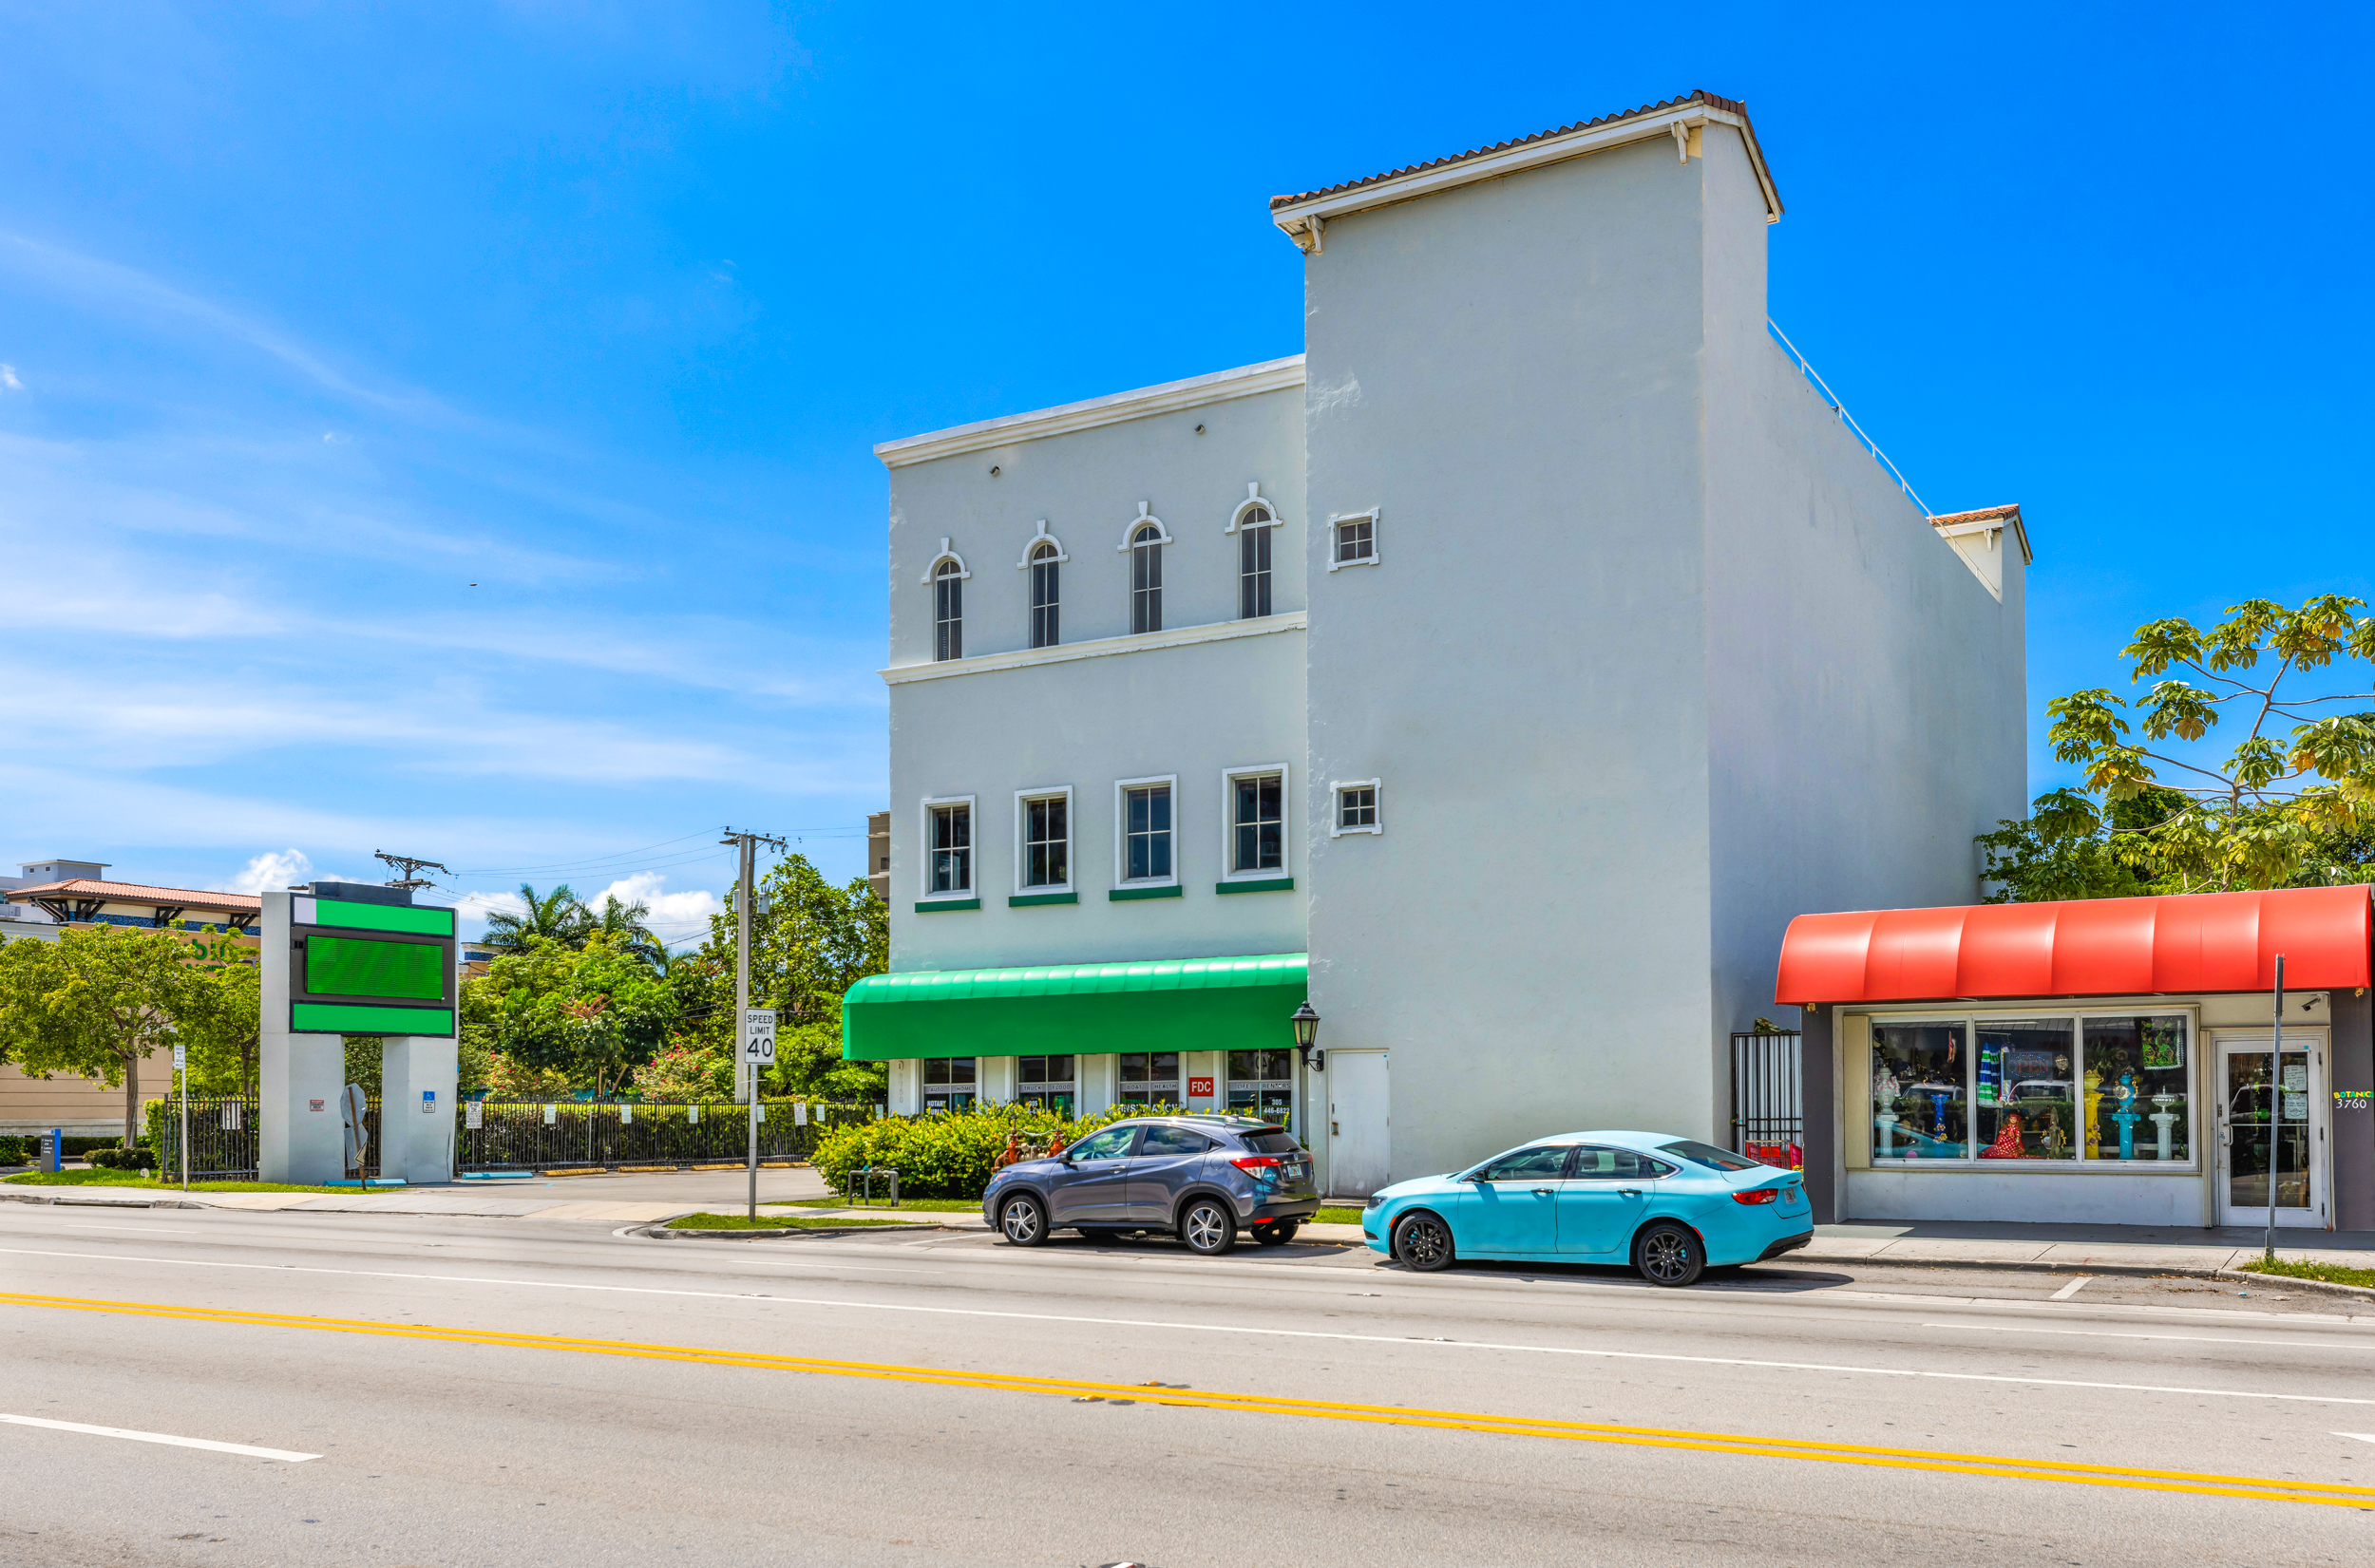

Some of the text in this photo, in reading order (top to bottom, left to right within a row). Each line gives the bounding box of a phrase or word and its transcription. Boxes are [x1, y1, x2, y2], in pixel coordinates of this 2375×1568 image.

[747, 1014, 773, 1024] SPEED
[750, 1027, 770, 1035] LIMIT
[747, 1037, 773, 1058] 40
[2006, 1059, 2048, 1072] OPEN
[1191, 1081, 1211, 1092] FDC
[2333, 1090, 2374, 1099] BOTANICA
[2335, 1098, 2366, 1109] 3760
